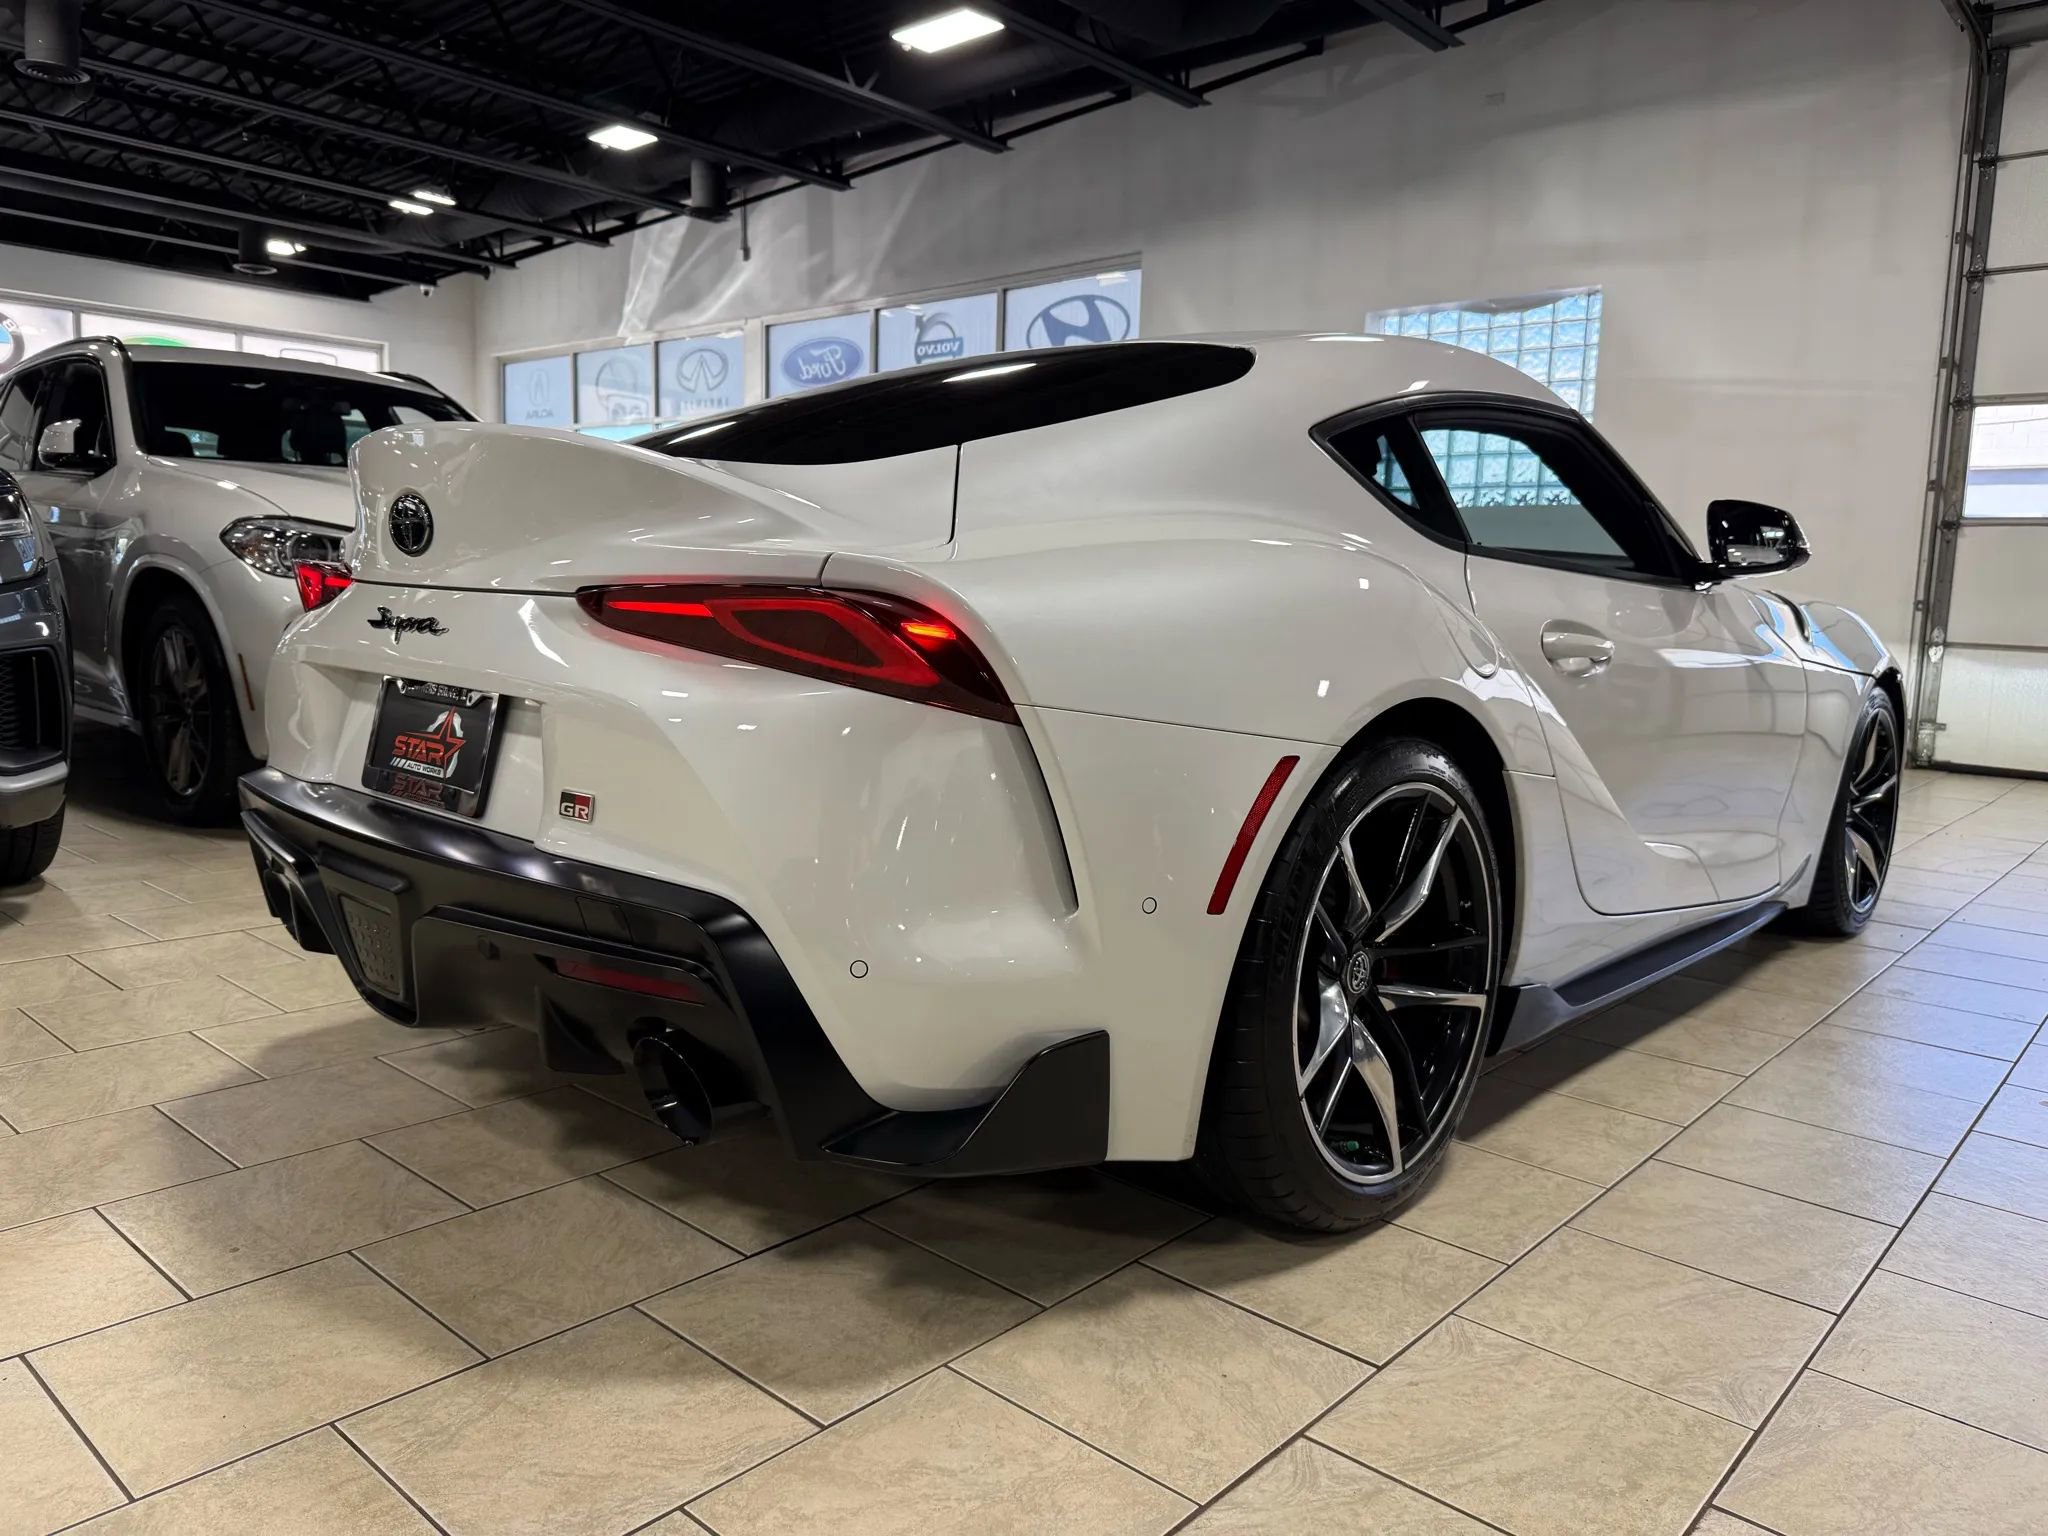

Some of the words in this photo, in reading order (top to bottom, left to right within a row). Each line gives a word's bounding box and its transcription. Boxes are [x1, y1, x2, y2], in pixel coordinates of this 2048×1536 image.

[367, 606, 449, 645] Supra
[392, 735, 446, 765] STAR
[407, 761, 421, 771] AUTO
[422, 765, 442, 776] WORKS
[560, 802, 589, 820] GR
